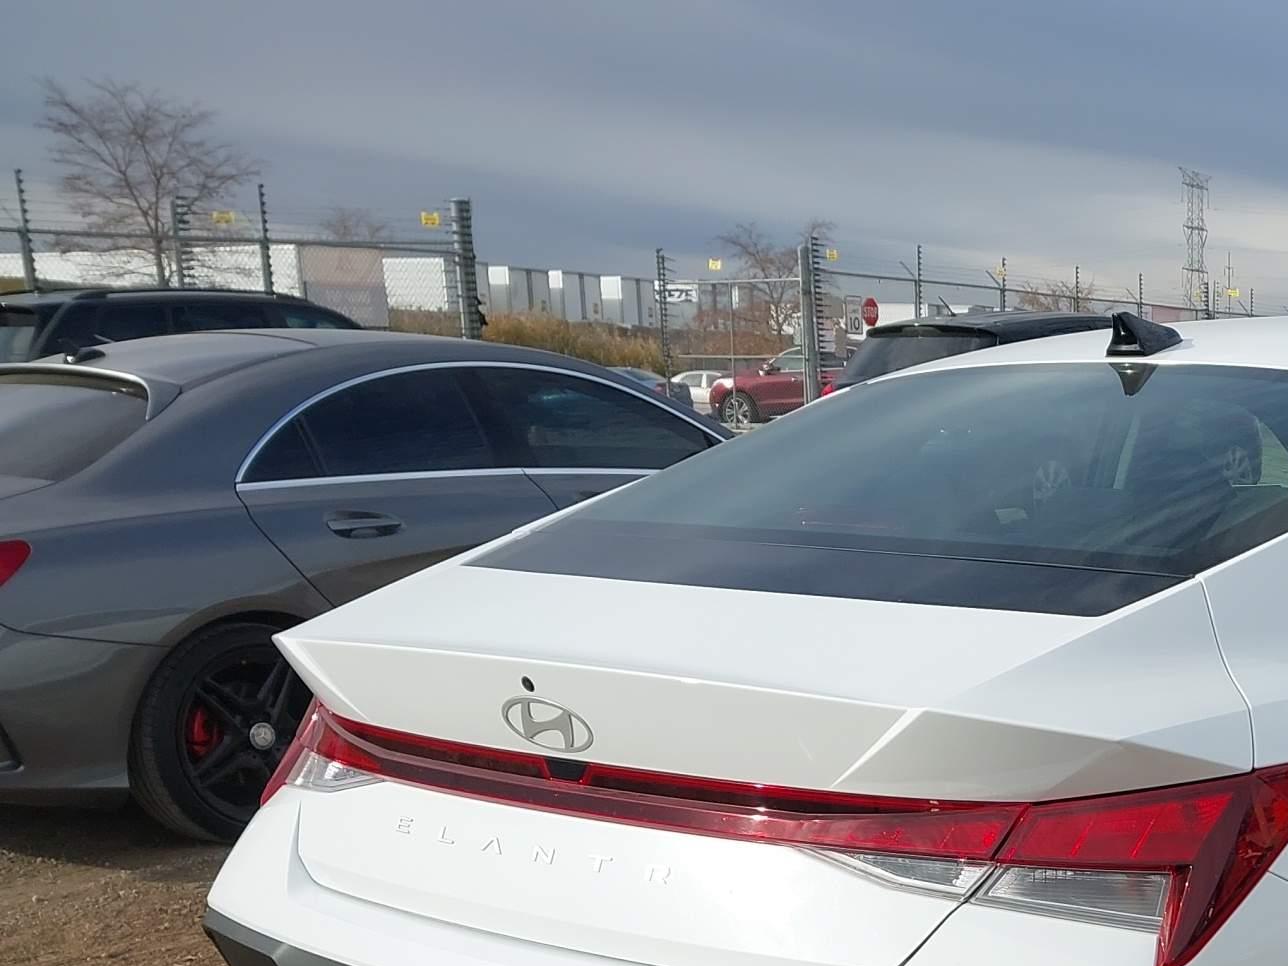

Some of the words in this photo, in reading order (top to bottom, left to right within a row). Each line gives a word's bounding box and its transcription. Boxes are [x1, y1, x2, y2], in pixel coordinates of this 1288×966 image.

[864, 306, 878, 318] STOP
[850, 316, 860, 330] 10
[396, 815, 676, 886] ELANTR
